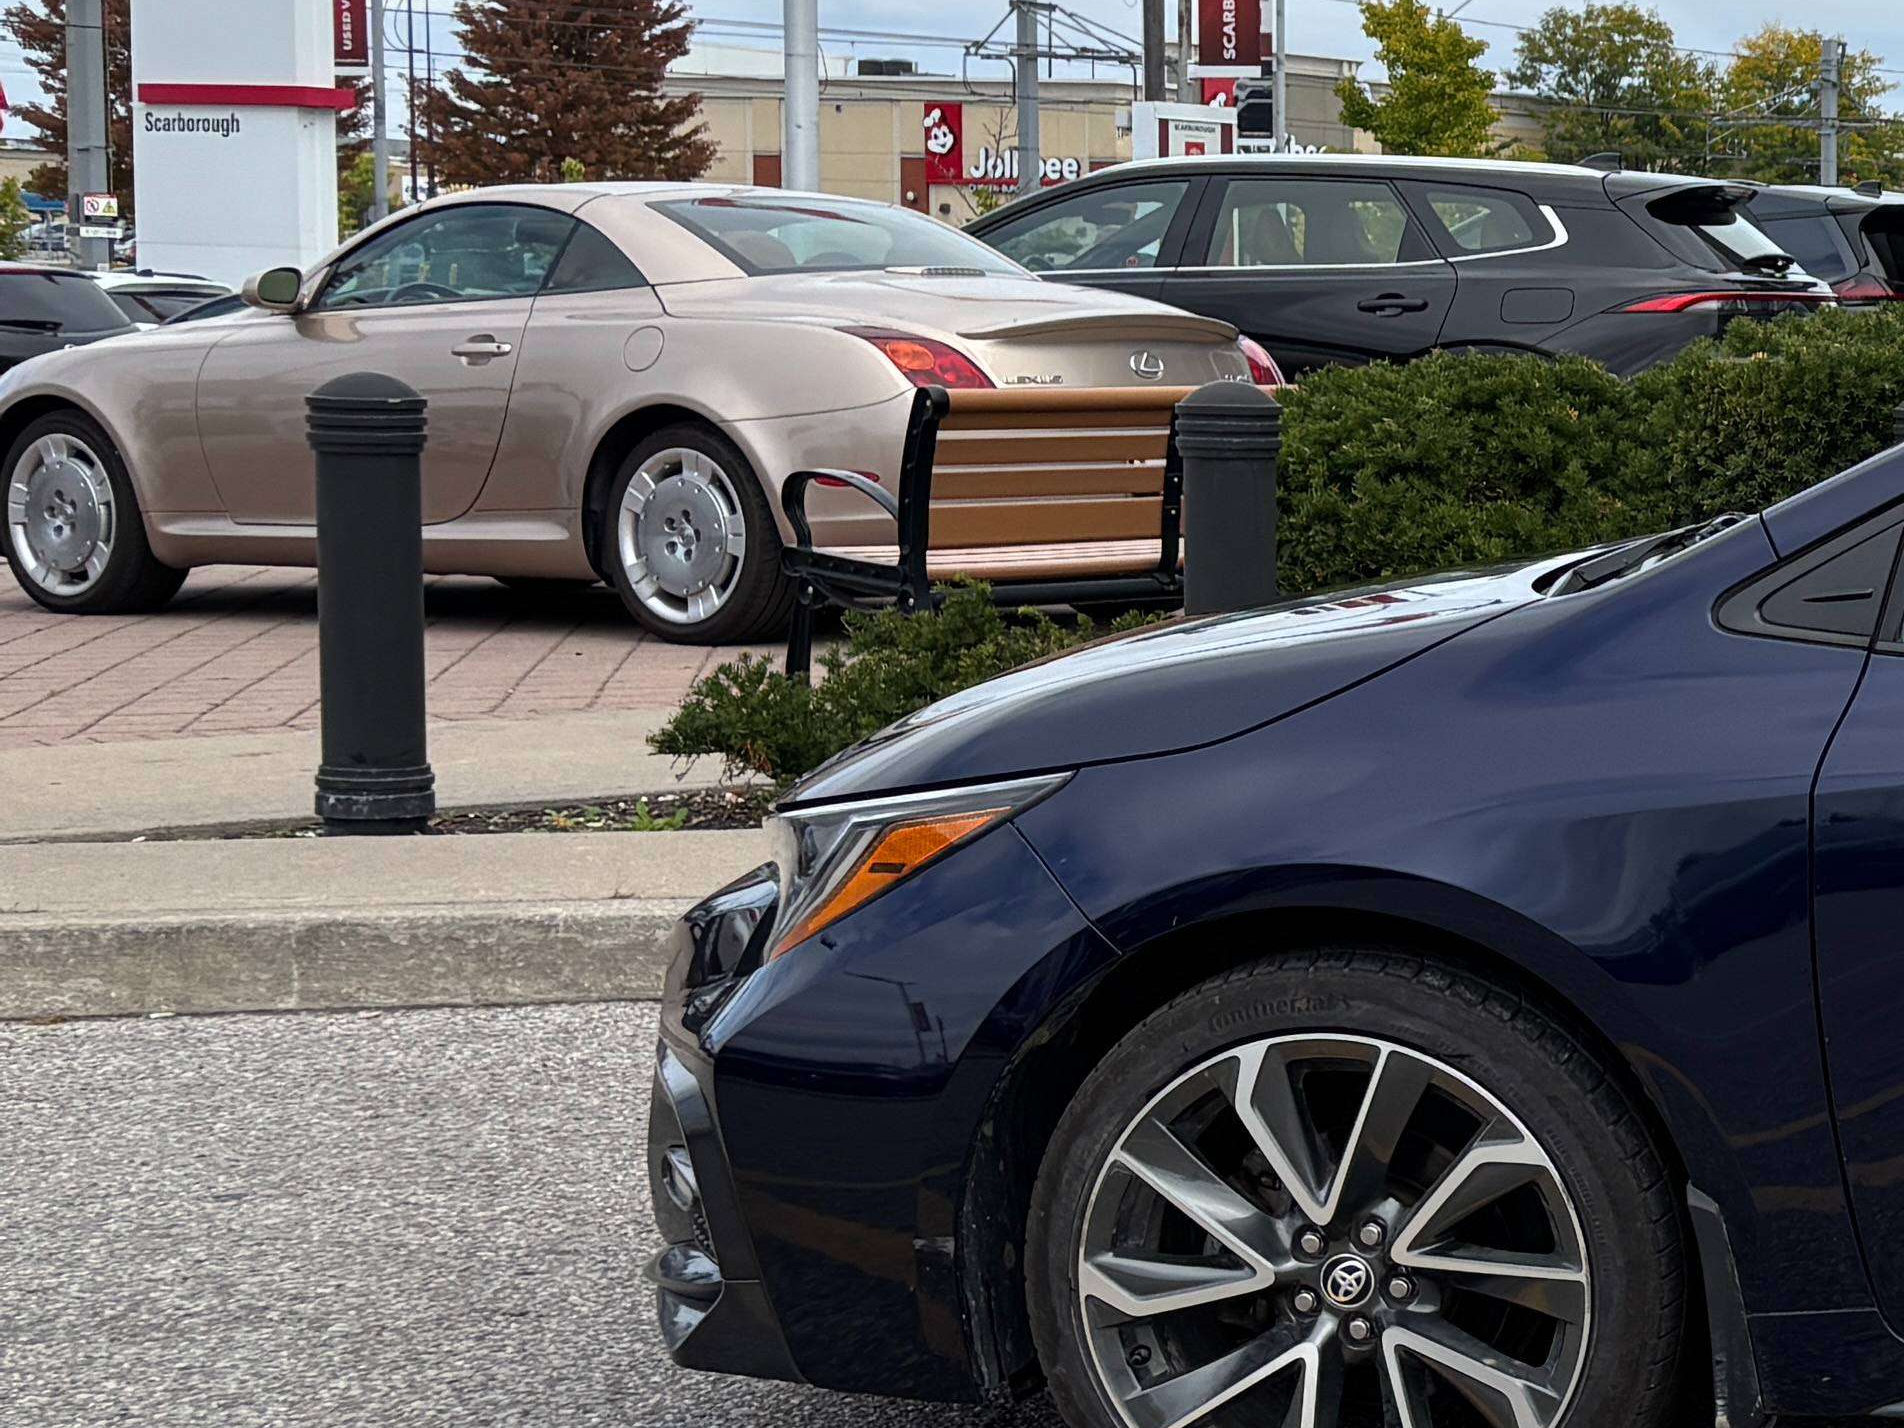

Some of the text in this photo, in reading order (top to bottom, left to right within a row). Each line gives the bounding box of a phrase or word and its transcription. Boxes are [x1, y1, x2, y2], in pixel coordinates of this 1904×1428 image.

[342, 13, 353, 51] USED
[145, 112, 240, 137] Scarborough
[970, 147, 1080, 180] Jollee
